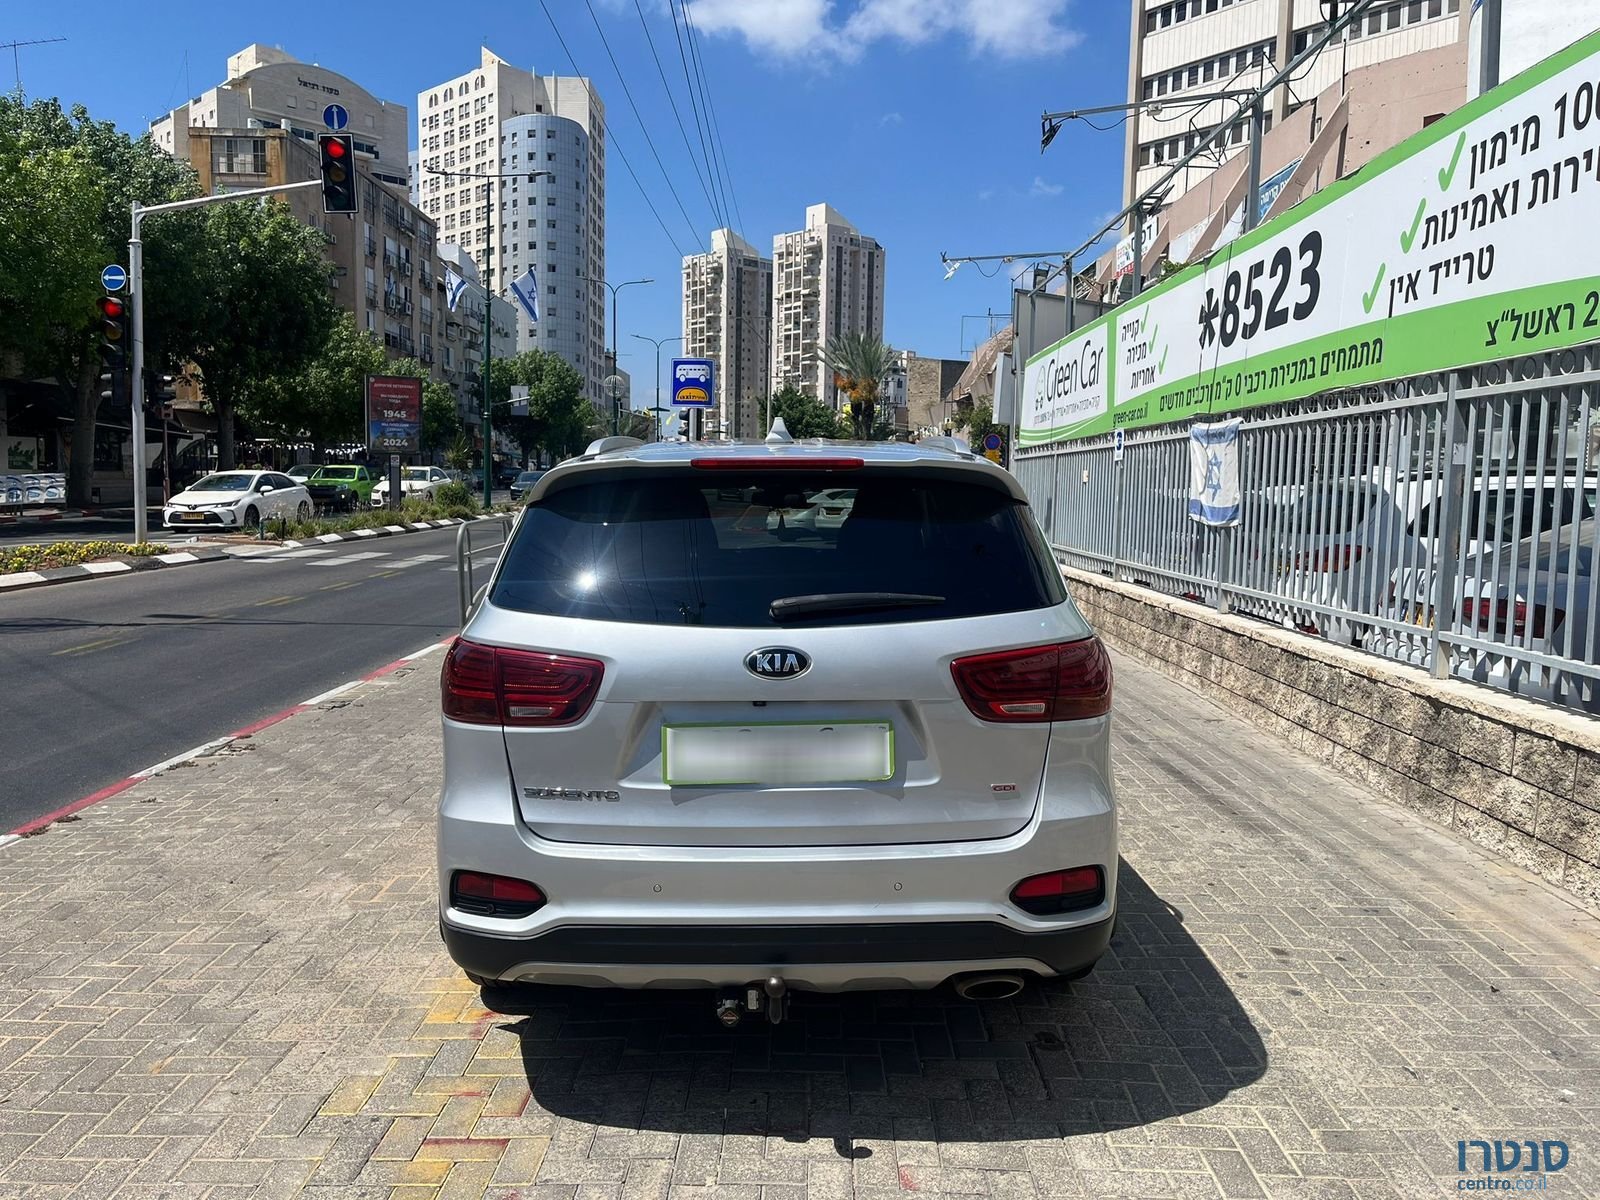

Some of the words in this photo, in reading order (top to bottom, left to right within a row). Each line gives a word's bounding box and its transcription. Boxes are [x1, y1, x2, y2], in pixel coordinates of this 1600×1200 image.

[1554, 81, 1600, 139] 10
[1469, 114, 1541, 190] מימון
[1527, 145, 1600, 210] ירות
[1421, 178, 1520, 250] ואמינות
[1428, 244, 1495, 295] טרייד
[1388, 269, 1421, 318] אין
[1121, 318, 1140, 342] קנייה
[1126, 341, 1147, 365] מכירה
[1320, 337, 1383, 376] מתמחים
[1046, 358, 1078, 402] Green
[1080, 340, 1104, 390] Car
[1130, 365, 1156, 390] אחריות
[1244, 370, 1266, 395] רכבי
[1268, 356, 1316, 389] במכירת
[1234, 372, 1241, 396] 0
[383, 410, 407, 418] 1945
[1159, 391, 1184, 412] חדשים
[1113, 401, 1148, 428] green-car.co.il
[383, 438, 408, 446] 2024
[756, 653, 800, 672] KIA
[523, 787, 620, 802] SORENTO
[993, 784, 1016, 792] GDI
